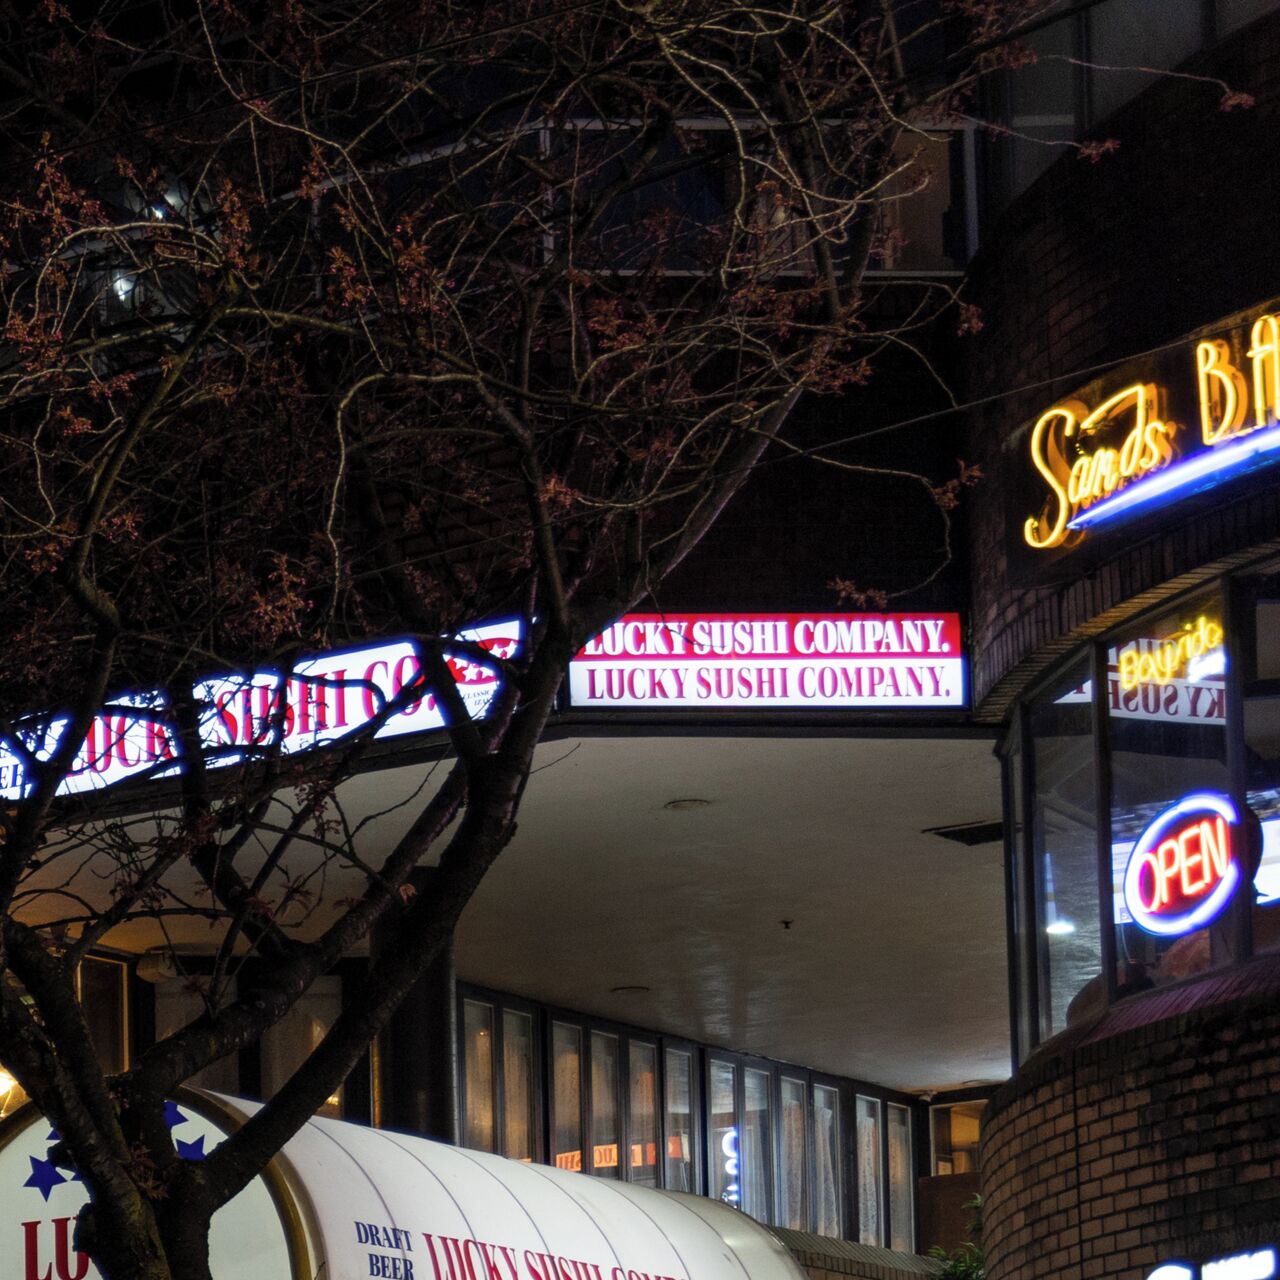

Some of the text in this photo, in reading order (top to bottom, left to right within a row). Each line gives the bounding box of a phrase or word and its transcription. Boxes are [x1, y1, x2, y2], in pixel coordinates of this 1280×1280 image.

[1024, 384, 1169, 547] Sands
[584, 618, 951, 656] LUCKY SUSHI COMPANY.
[586, 665, 952, 700] LUCKY SUSHI COMPANY.
[1139, 814, 1231, 914] OPEN
[354, 1220, 414, 1253] DRAFT
